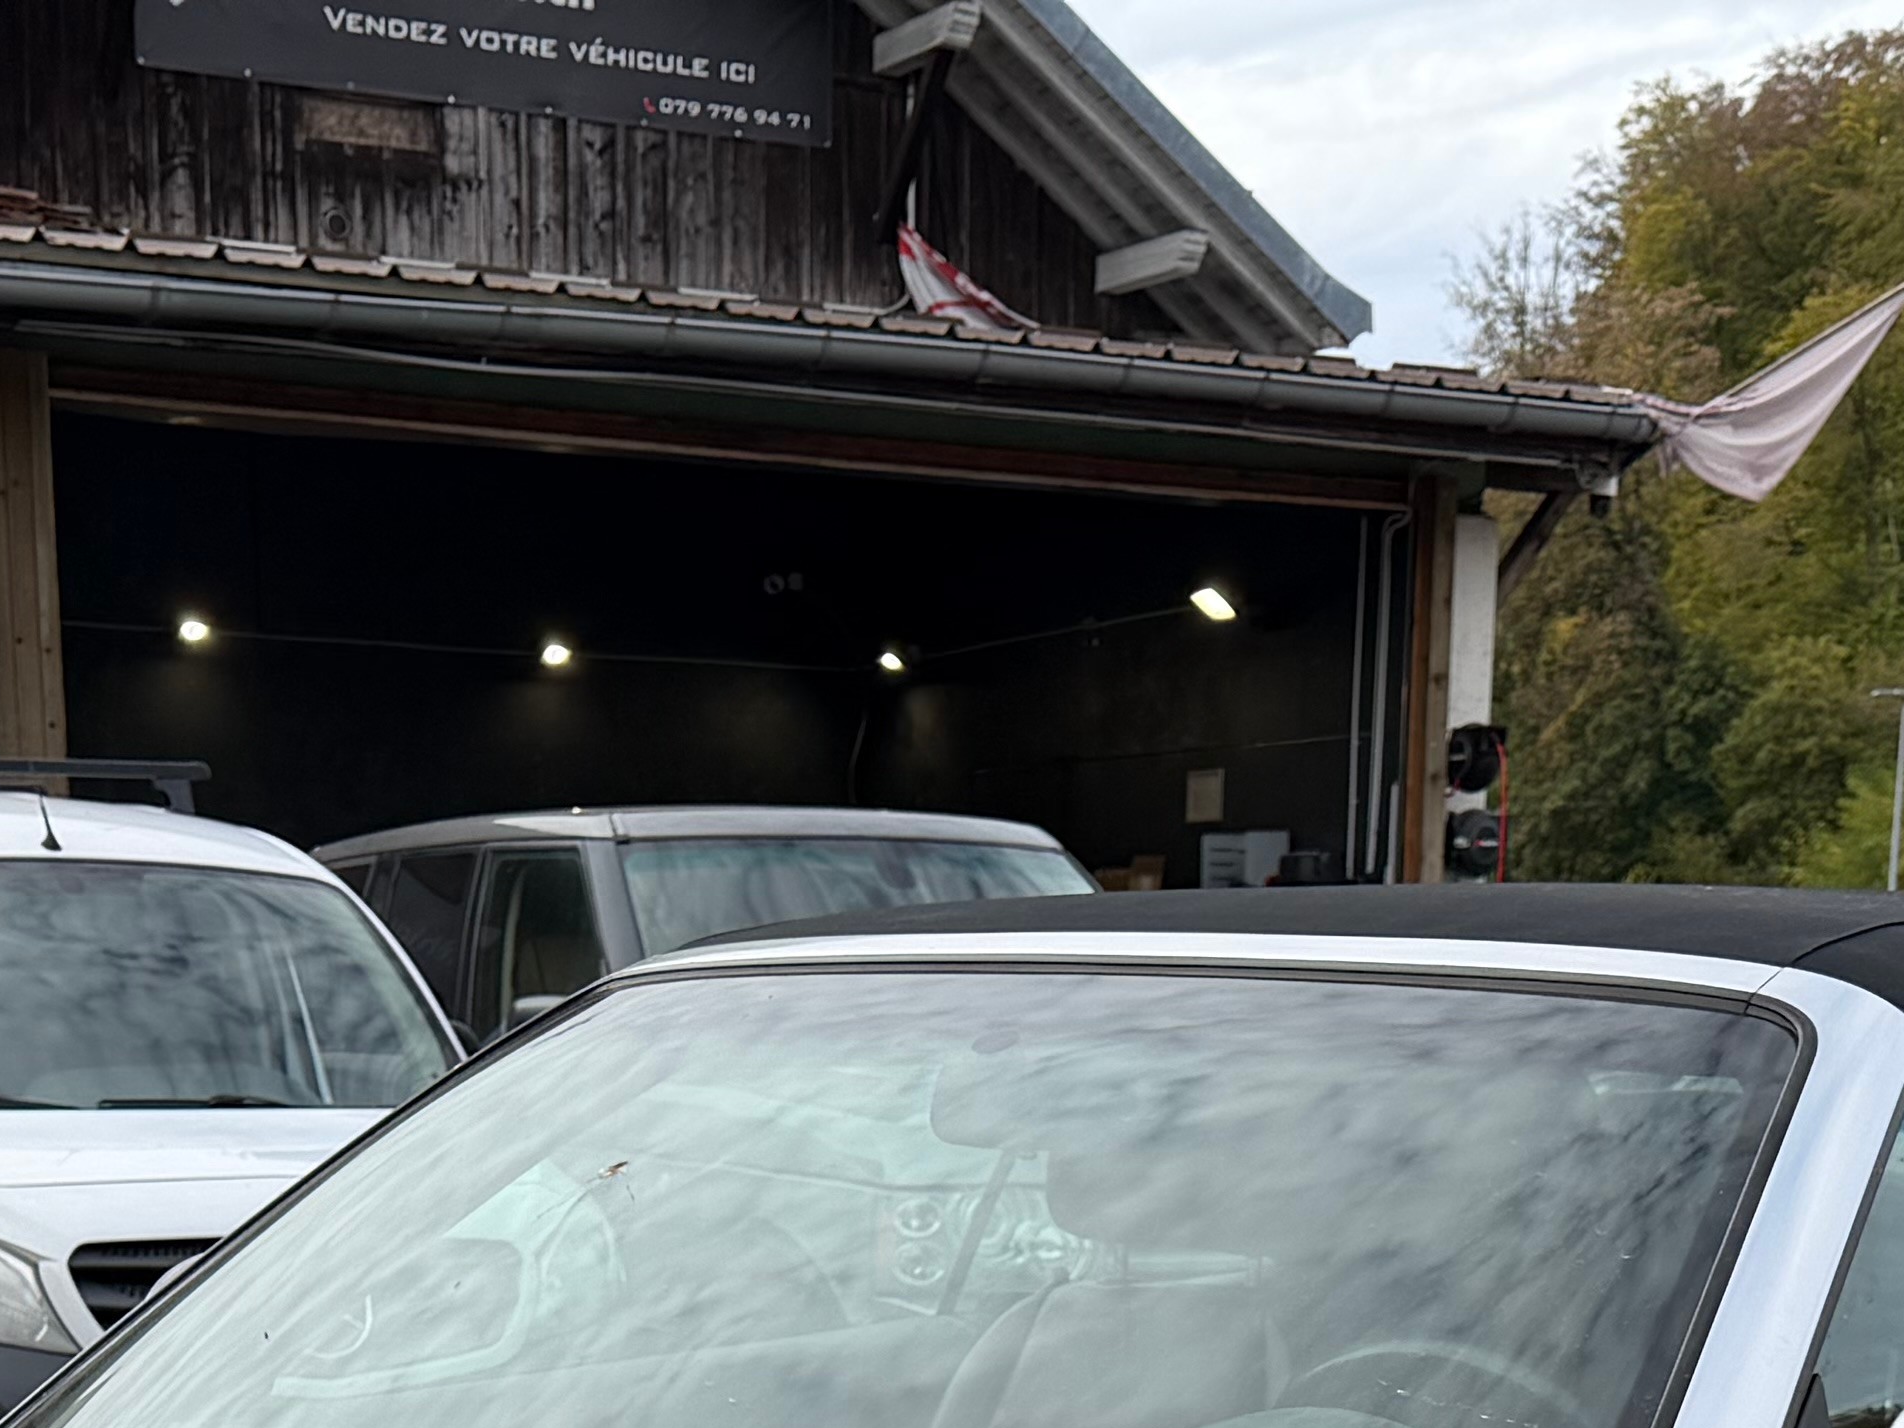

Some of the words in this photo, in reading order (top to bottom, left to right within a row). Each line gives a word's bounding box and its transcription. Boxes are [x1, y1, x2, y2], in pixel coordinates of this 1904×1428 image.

[322, 5, 448, 45] VENDEZ
[459, 26, 558, 59] VOTRE
[568, 38, 710, 80] VÉHICULE
[720, 60, 756, 84] ICI
[659, 97, 702, 118] 079
[706, 102, 748, 123] 776
[753, 108, 781, 127] 94
[786, 112, 811, 131] 71
